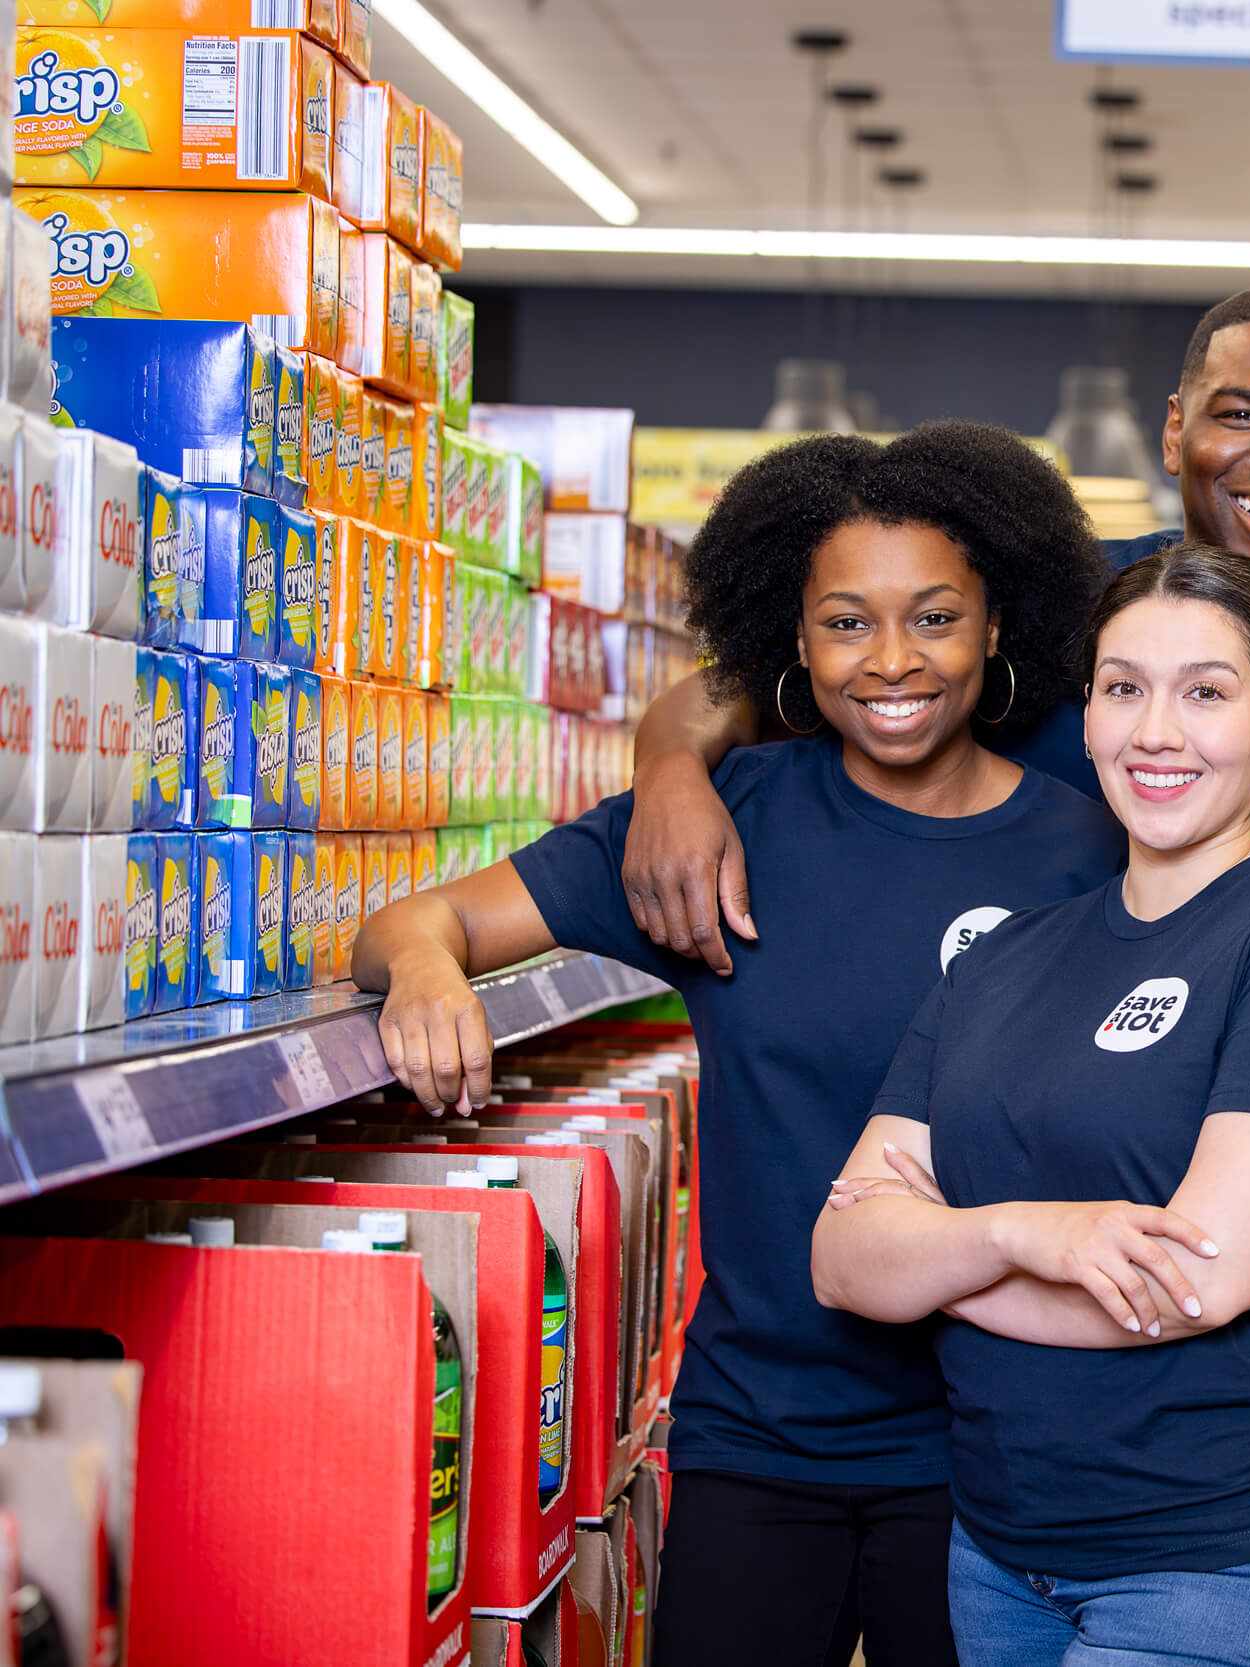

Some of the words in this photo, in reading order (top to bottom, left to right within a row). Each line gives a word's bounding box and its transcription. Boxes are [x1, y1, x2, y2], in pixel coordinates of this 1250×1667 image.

[186, 41, 215, 49] Nutrition
[217, 41, 236, 50] Facts
[220, 65, 236, 75] 200
[14, 49, 120, 125] risp
[15, 121, 38, 134] NGE
[41, 119, 75, 132] SODA
[41, 211, 131, 287] isp
[51, 279, 84, 292] SODA
[246, 530, 276, 601] crisp
[283, 544, 316, 616] crisp
[153, 692, 187, 764] crisp
[203, 696, 235, 764] crisp
[161, 871, 191, 947] crisp
[204, 868, 231, 940] crisp
[1109, 1012, 1121, 1023] a
[1115, 1012, 1166, 1034] lot
[1119, 995, 1178, 1011] save
[538, 1524, 569, 1580] BOARDWALK
